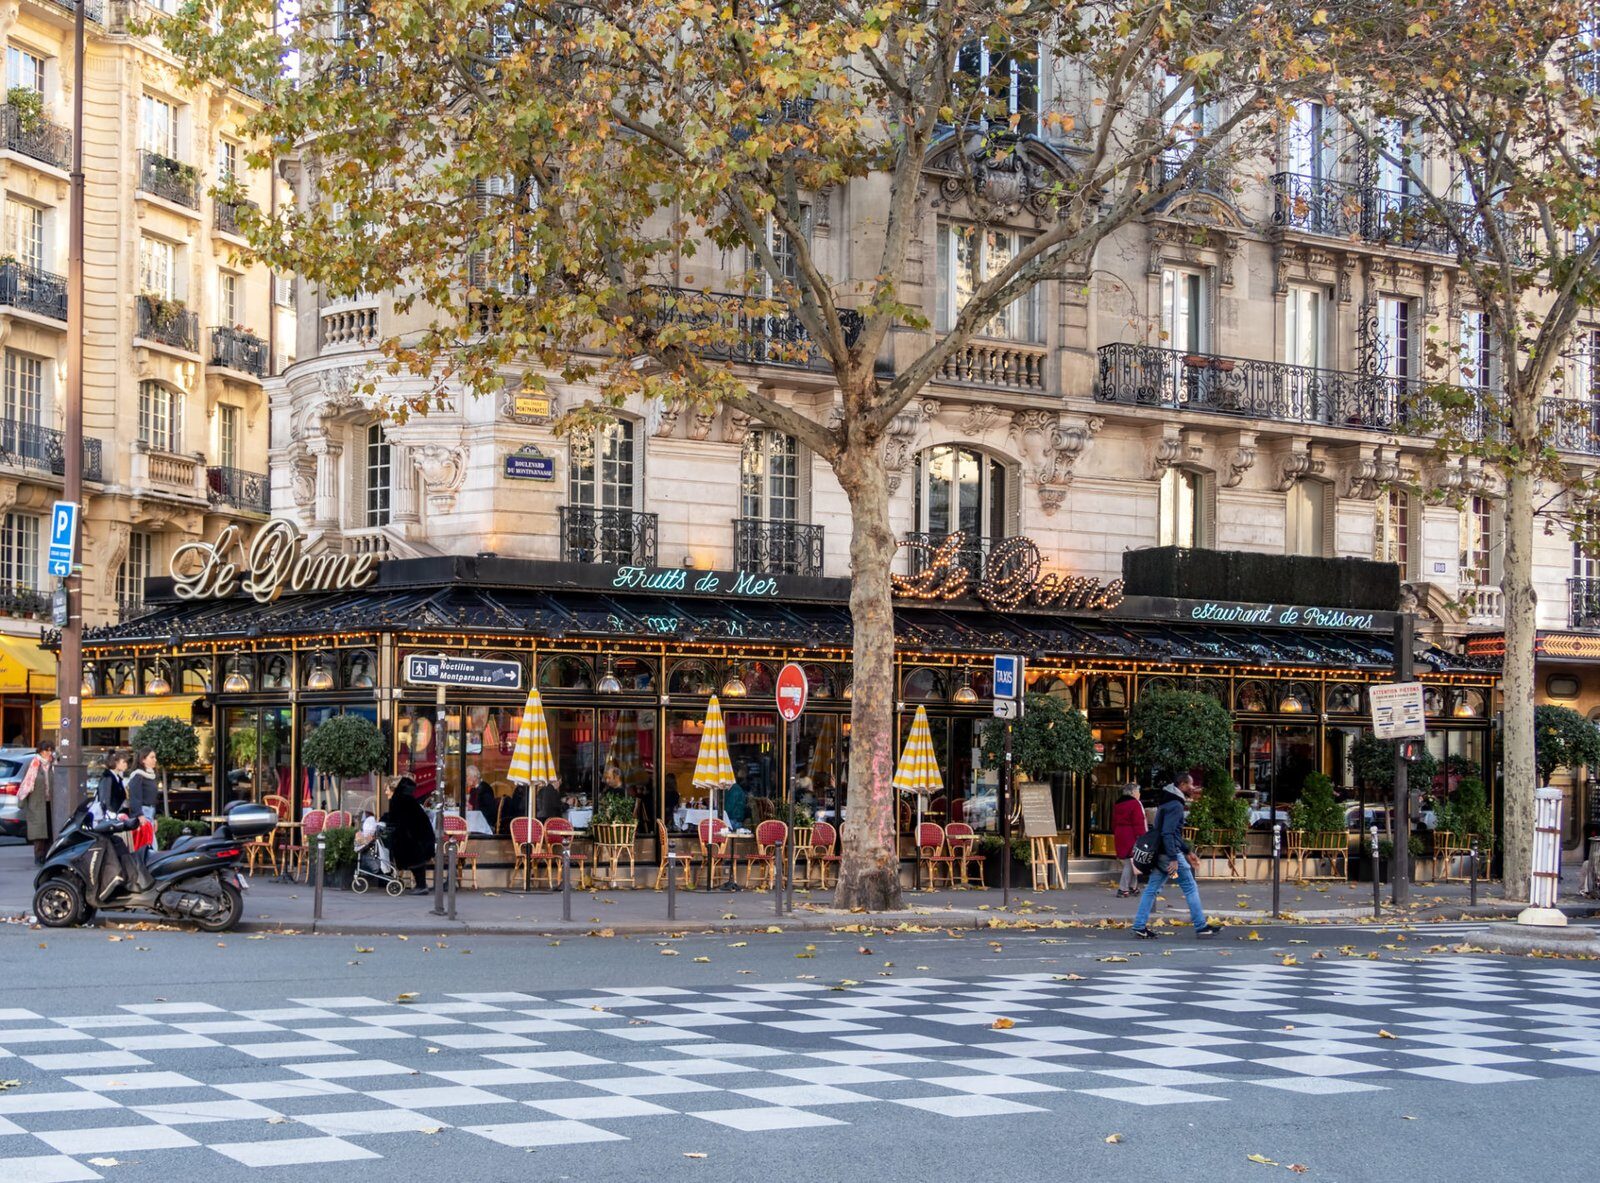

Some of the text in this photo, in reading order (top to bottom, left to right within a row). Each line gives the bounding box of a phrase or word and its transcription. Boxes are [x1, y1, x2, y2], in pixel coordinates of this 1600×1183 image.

[515, 460, 545, 469] BOULEVARD
[515, 468, 552, 476] MONTPARNASSE
[56, 510, 69, 539] P
[170, 525, 239, 599] Le
[890, 529, 969, 600] Le
[612, 566, 779, 596] Fruits de Mer
[1191, 602, 1374, 629] estaurant de Poissons
[440, 661, 475, 672] Noctilien
[439, 672, 492, 683] Montparnasse
[996, 670, 1013, 684] TAXIS
[114, 708, 125, 721] de
